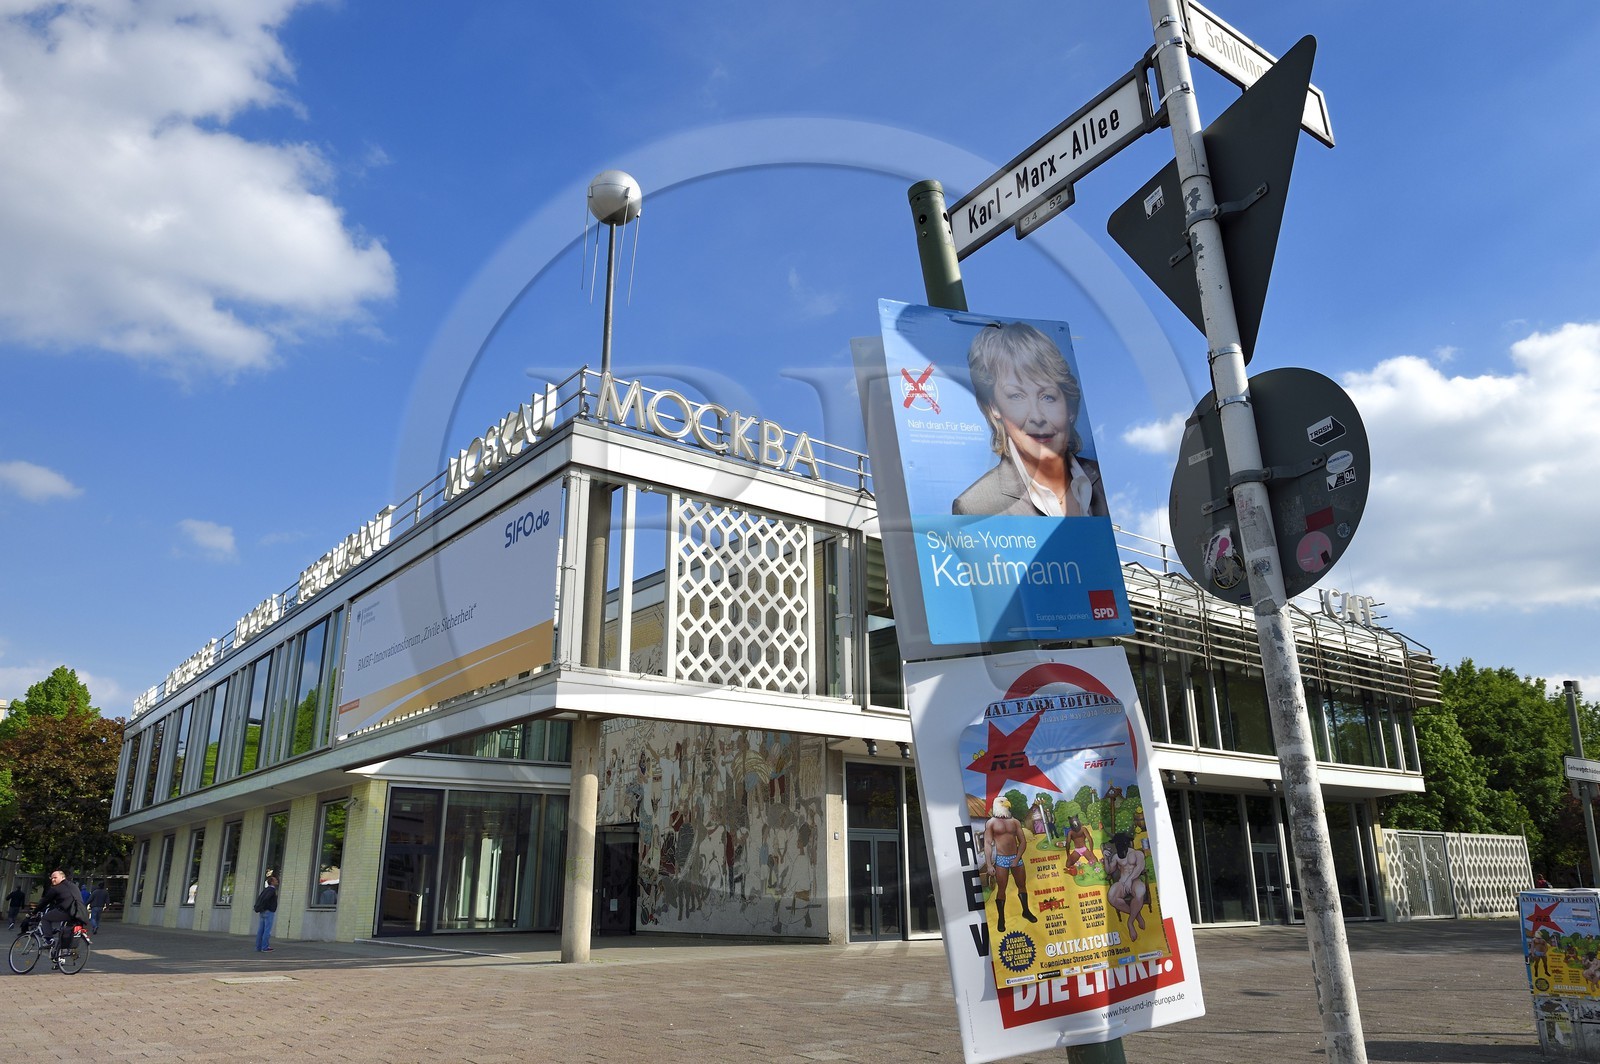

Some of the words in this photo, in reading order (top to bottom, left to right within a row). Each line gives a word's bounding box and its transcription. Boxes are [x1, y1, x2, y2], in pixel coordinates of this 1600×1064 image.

[968, 109, 1120, 234] Karl-Marx-Allee
[1024, 211, 1038, 226] 34
[1049, 194, 1062, 210] 52
[904, 382, 918, 392] 25.
[907, 419, 925, 429] Nah
[443, 383, 558, 501] MOSKAU
[504, 508, 550, 549] SIFO.de
[927, 531, 1037, 553] Sylvia-Yvonne
[930, 554, 1083, 588] Kaufmann
[1036, 613, 1056, 621] Europa
[1093, 607, 1115, 619] SPD
[1016, 699, 1055, 713] FARM
[1083, 757, 1118, 770] PARTY
[1045, 931, 1121, 957] @KITKATCLUB
[1072, 953, 1094, 964] Strasse
[1115, 946, 1131, 955] Berlin
[1013, 976, 1070, 1012] DIE
[1101, 992, 1185, 1020] www.hier-und-in-europa.de
